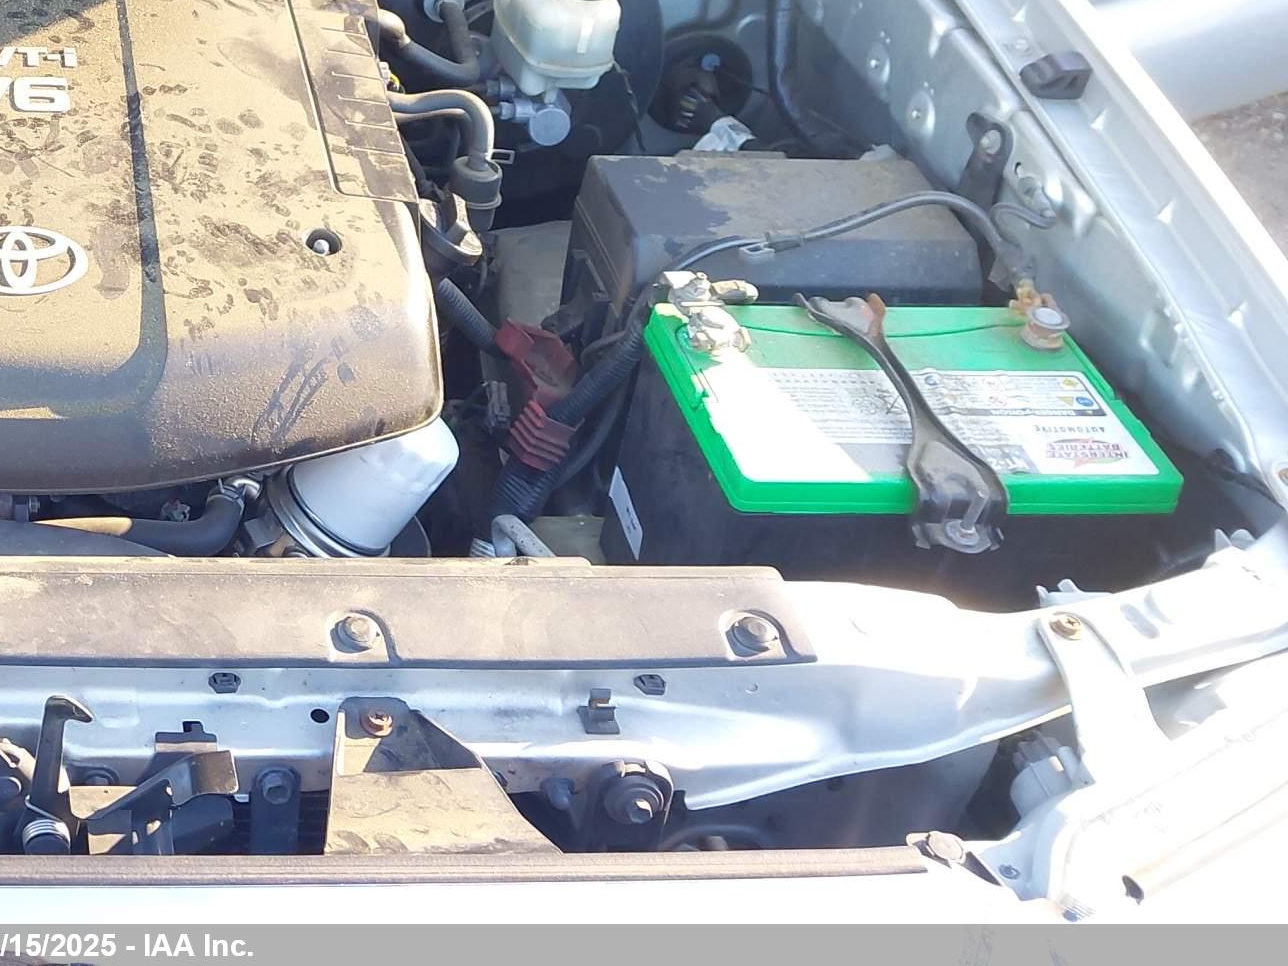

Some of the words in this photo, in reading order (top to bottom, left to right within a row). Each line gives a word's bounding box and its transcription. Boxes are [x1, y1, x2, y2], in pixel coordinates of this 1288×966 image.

[1034, 425, 1105, 434] AUTOMOTIVE
[1049, 443, 1120, 451] BATTERIES
[1047, 451, 1129, 459] INTERSTATE
